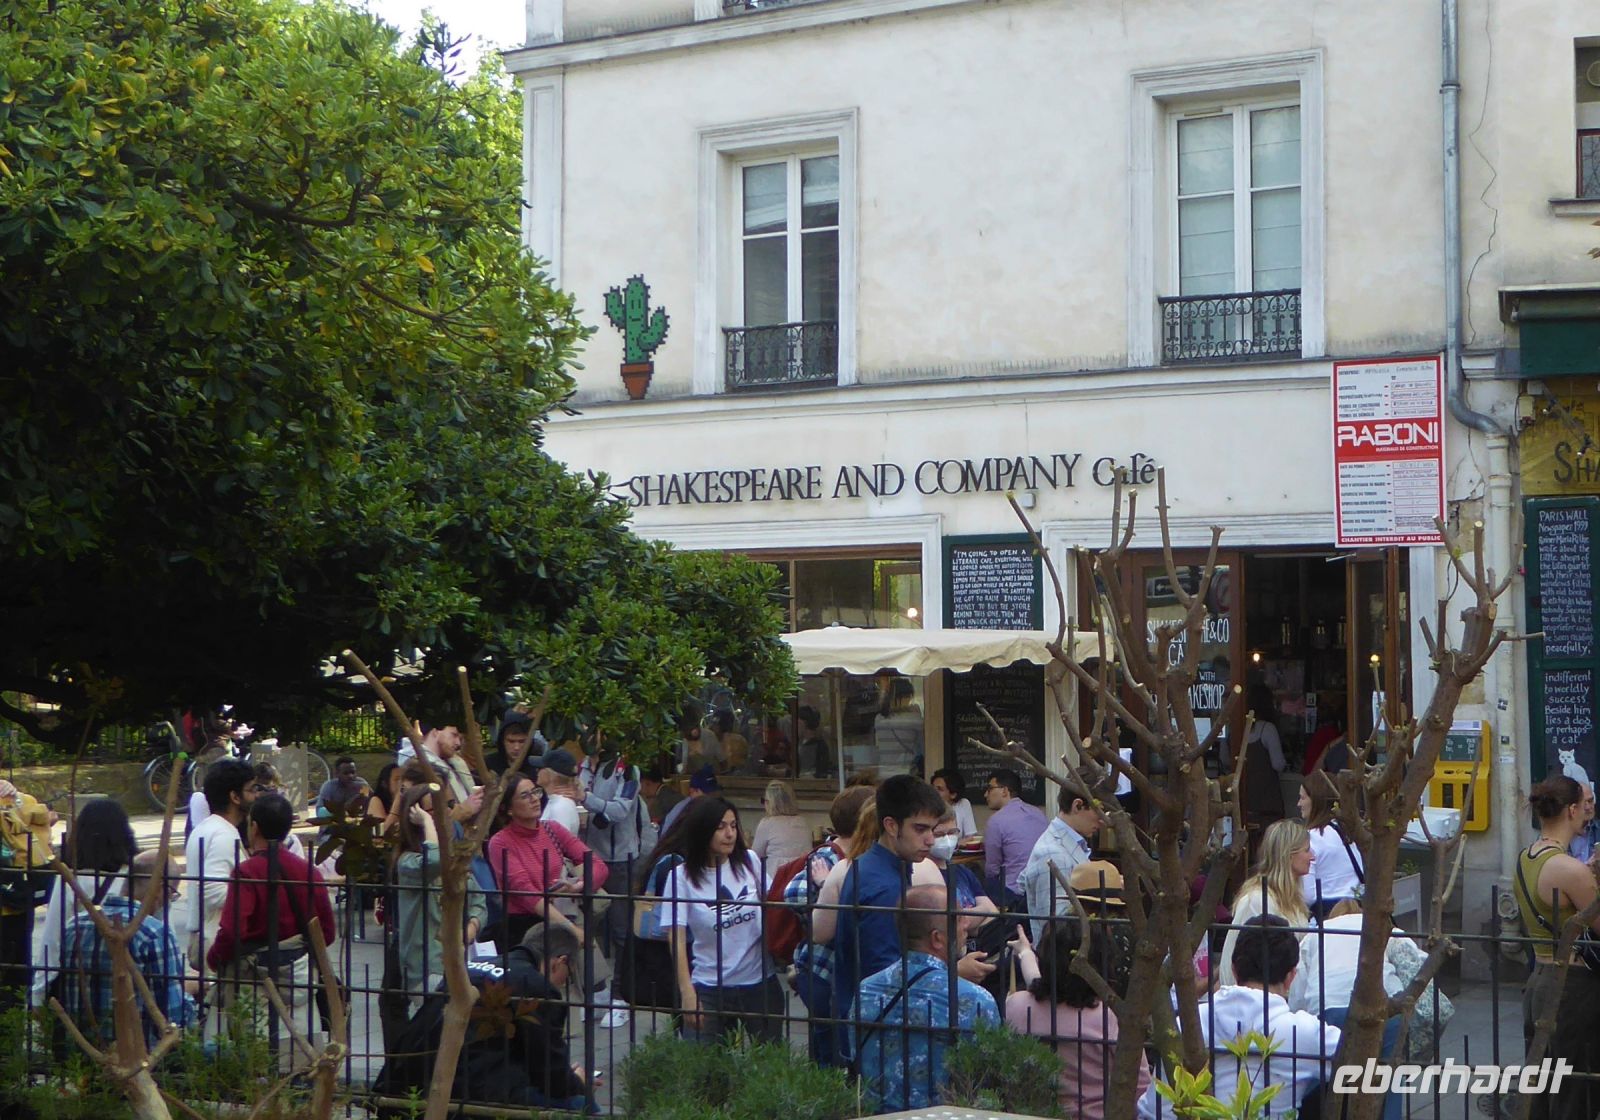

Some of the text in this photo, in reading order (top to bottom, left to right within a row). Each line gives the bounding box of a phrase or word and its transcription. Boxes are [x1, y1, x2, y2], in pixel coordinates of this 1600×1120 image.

[1338, 422, 1438, 447] RABONI
[606, 466, 823, 507] SHAKESPEARE
[832, 462, 905, 498] AND
[914, 453, 1082, 494] COMPANY
[1539, 510, 1588, 522] PARIS WALL
[1198, 671, 1216, 681] WITH
[1545, 670, 1591, 683] indifferent
[1545, 683, 1589, 696] to worldly
[1545, 704, 1591, 715] Beside him
[1546, 716, 1592, 729] lies a dog
[1556, 725, 1587, 736] perhaps
[1552, 736, 1557, 744] a
